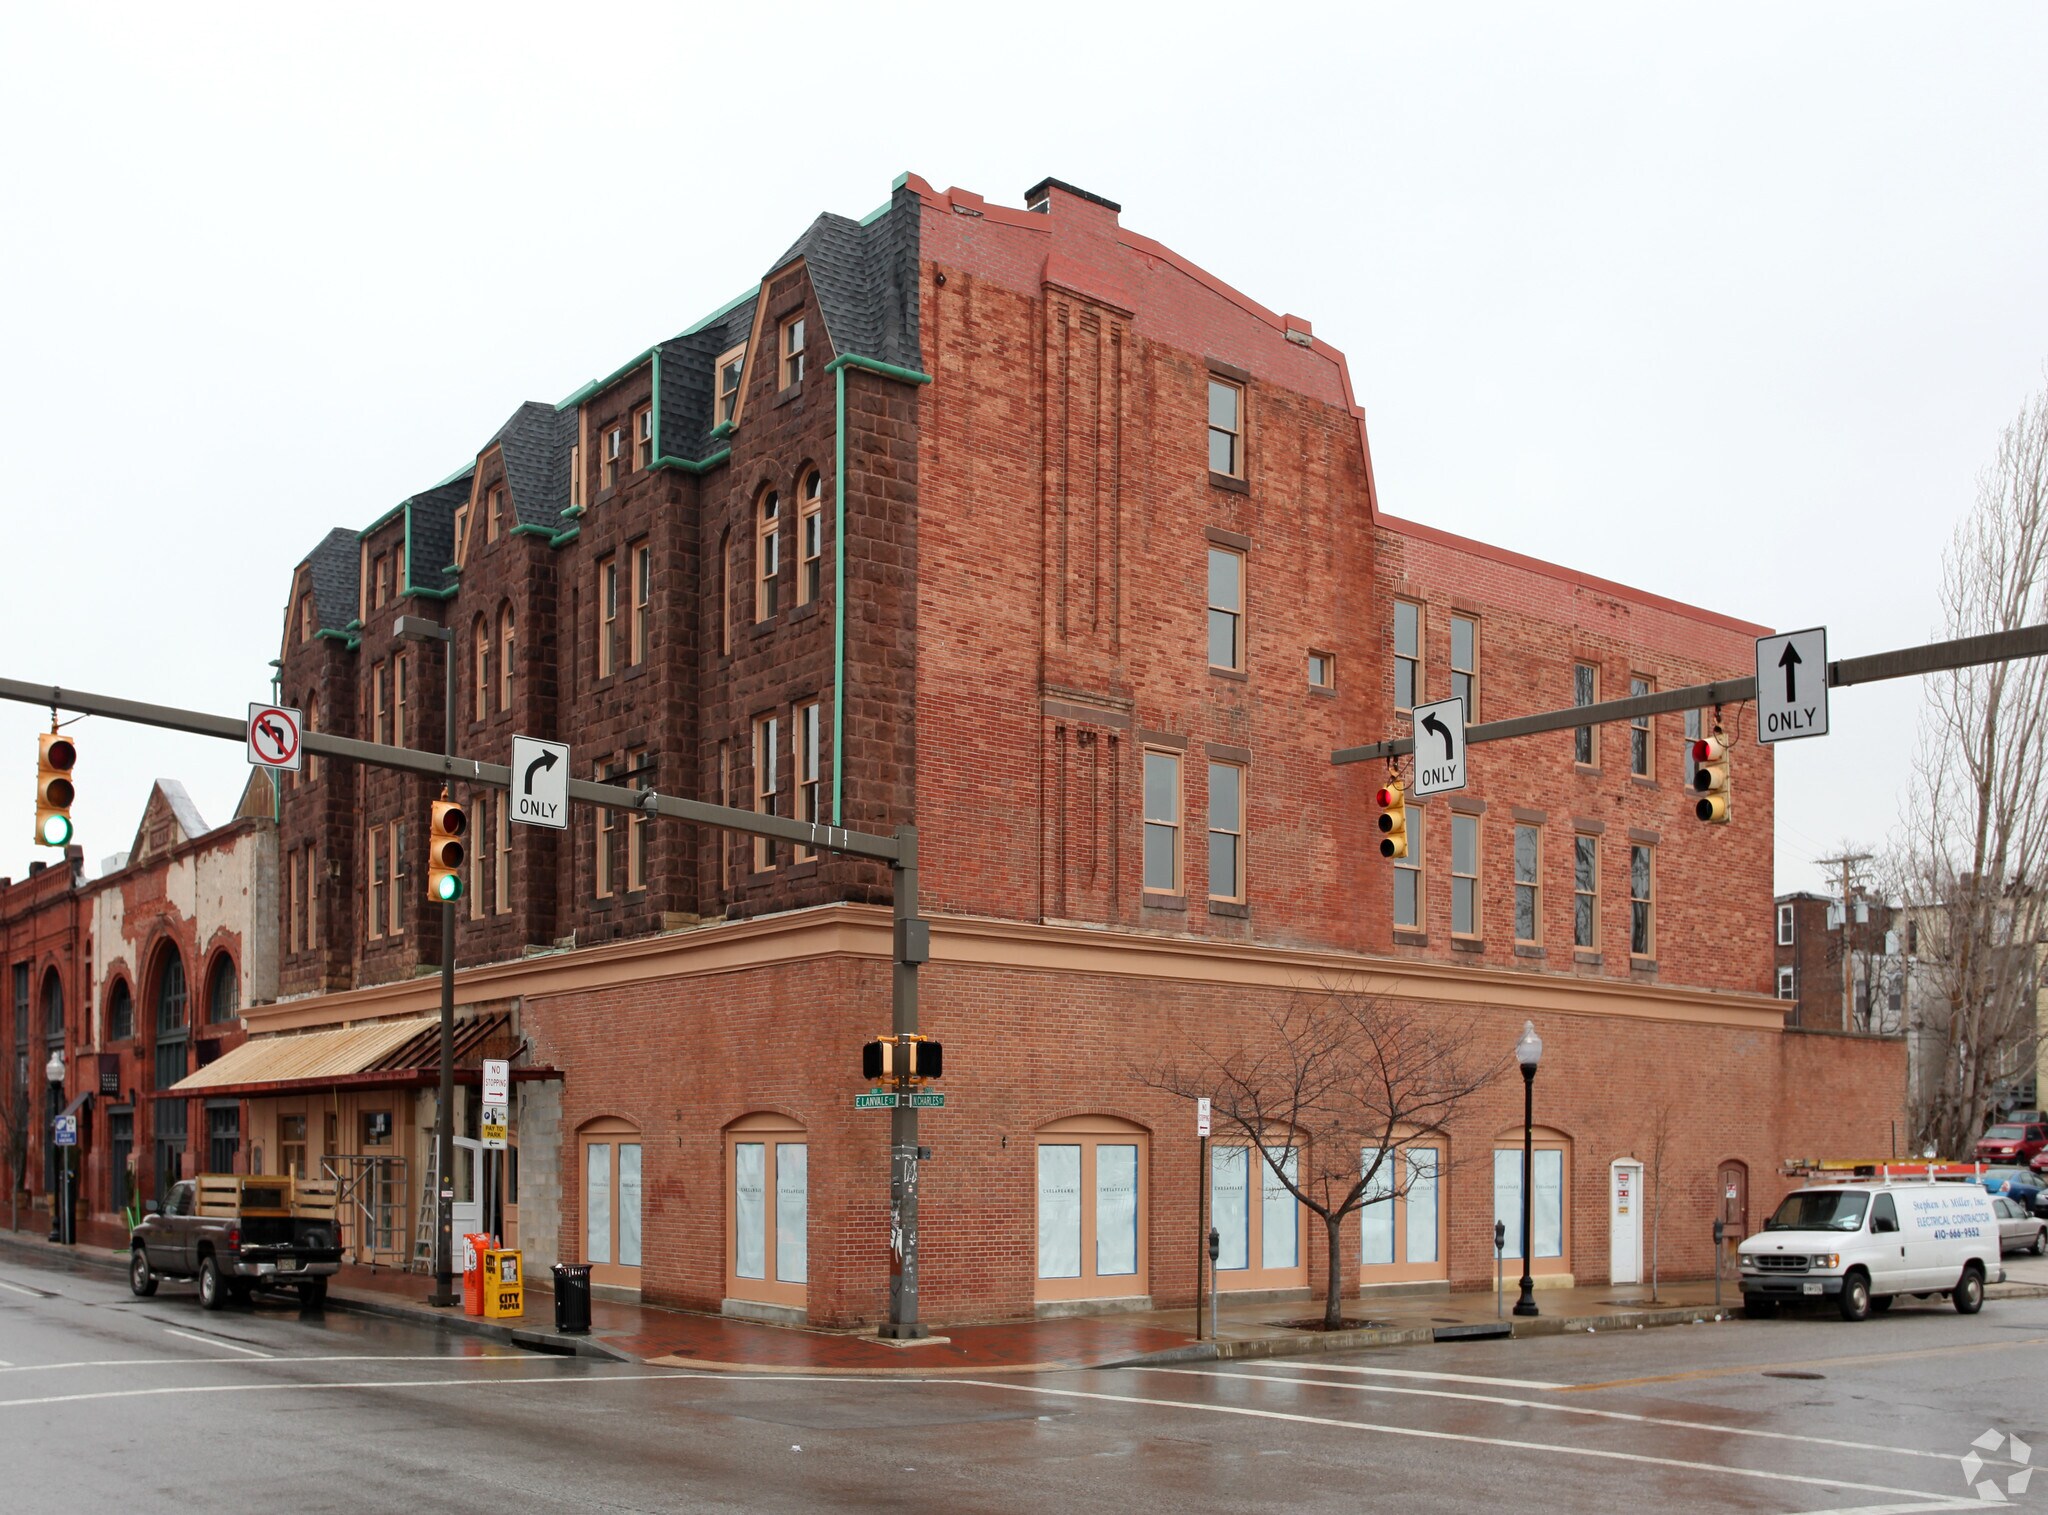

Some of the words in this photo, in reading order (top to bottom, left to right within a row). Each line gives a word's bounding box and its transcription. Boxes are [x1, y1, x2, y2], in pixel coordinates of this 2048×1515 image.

[1768, 706, 1816, 732] ONLY
[1422, 764, 1457, 786] ONLY
[520, 798, 558, 818] ONLY
[491, 1066, 500, 1074] NO
[486, 1079, 506, 1087] STOPPING
[856, 1098, 860, 1107] E
[861, 1096, 889, 1107] LANVALE
[918, 1096, 939, 1106] CHARLES
[1913, 1199, 1939, 1213] Stephen
[1916, 1216, 1950, 1227] ELECTRICAL
[1952, 1213, 1990, 1224] CONTRACTOR
[499, 1293, 520, 1304] CITY
[499, 1303, 520, 1311] PAPER
